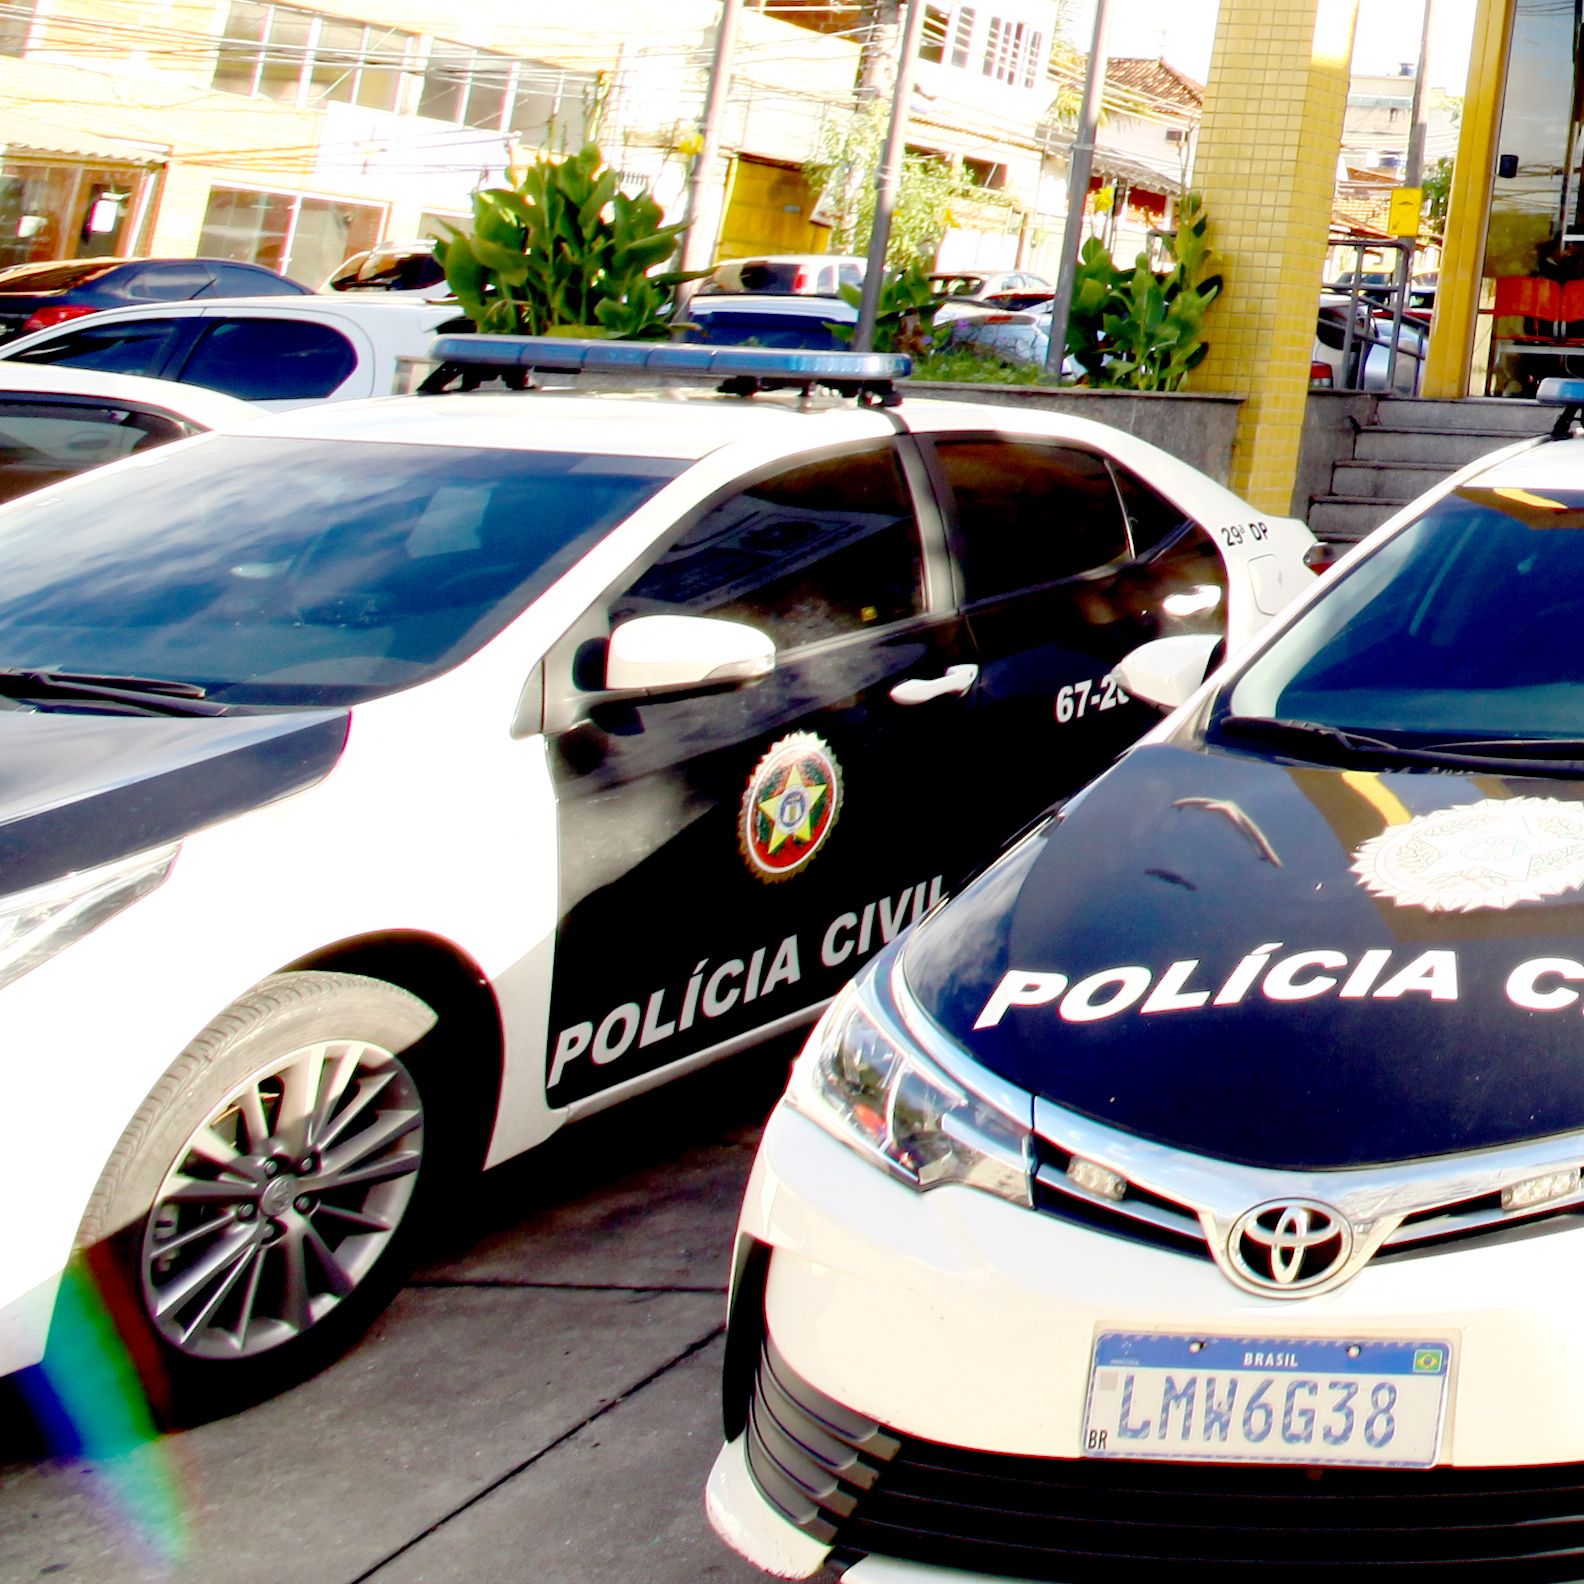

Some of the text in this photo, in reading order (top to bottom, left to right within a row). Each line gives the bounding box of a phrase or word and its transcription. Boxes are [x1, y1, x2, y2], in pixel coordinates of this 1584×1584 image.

[1249, 521, 1269, 541] DP
[973, 941, 1460, 1031] POLÍCIA
[546, 934, 801, 1089] POLÍCIA
[1242, 1352, 1299, 1369] BRASIL
[1116, 1374, 1399, 1449] LMW6G38
[1087, 1429, 1109, 1451] BR
